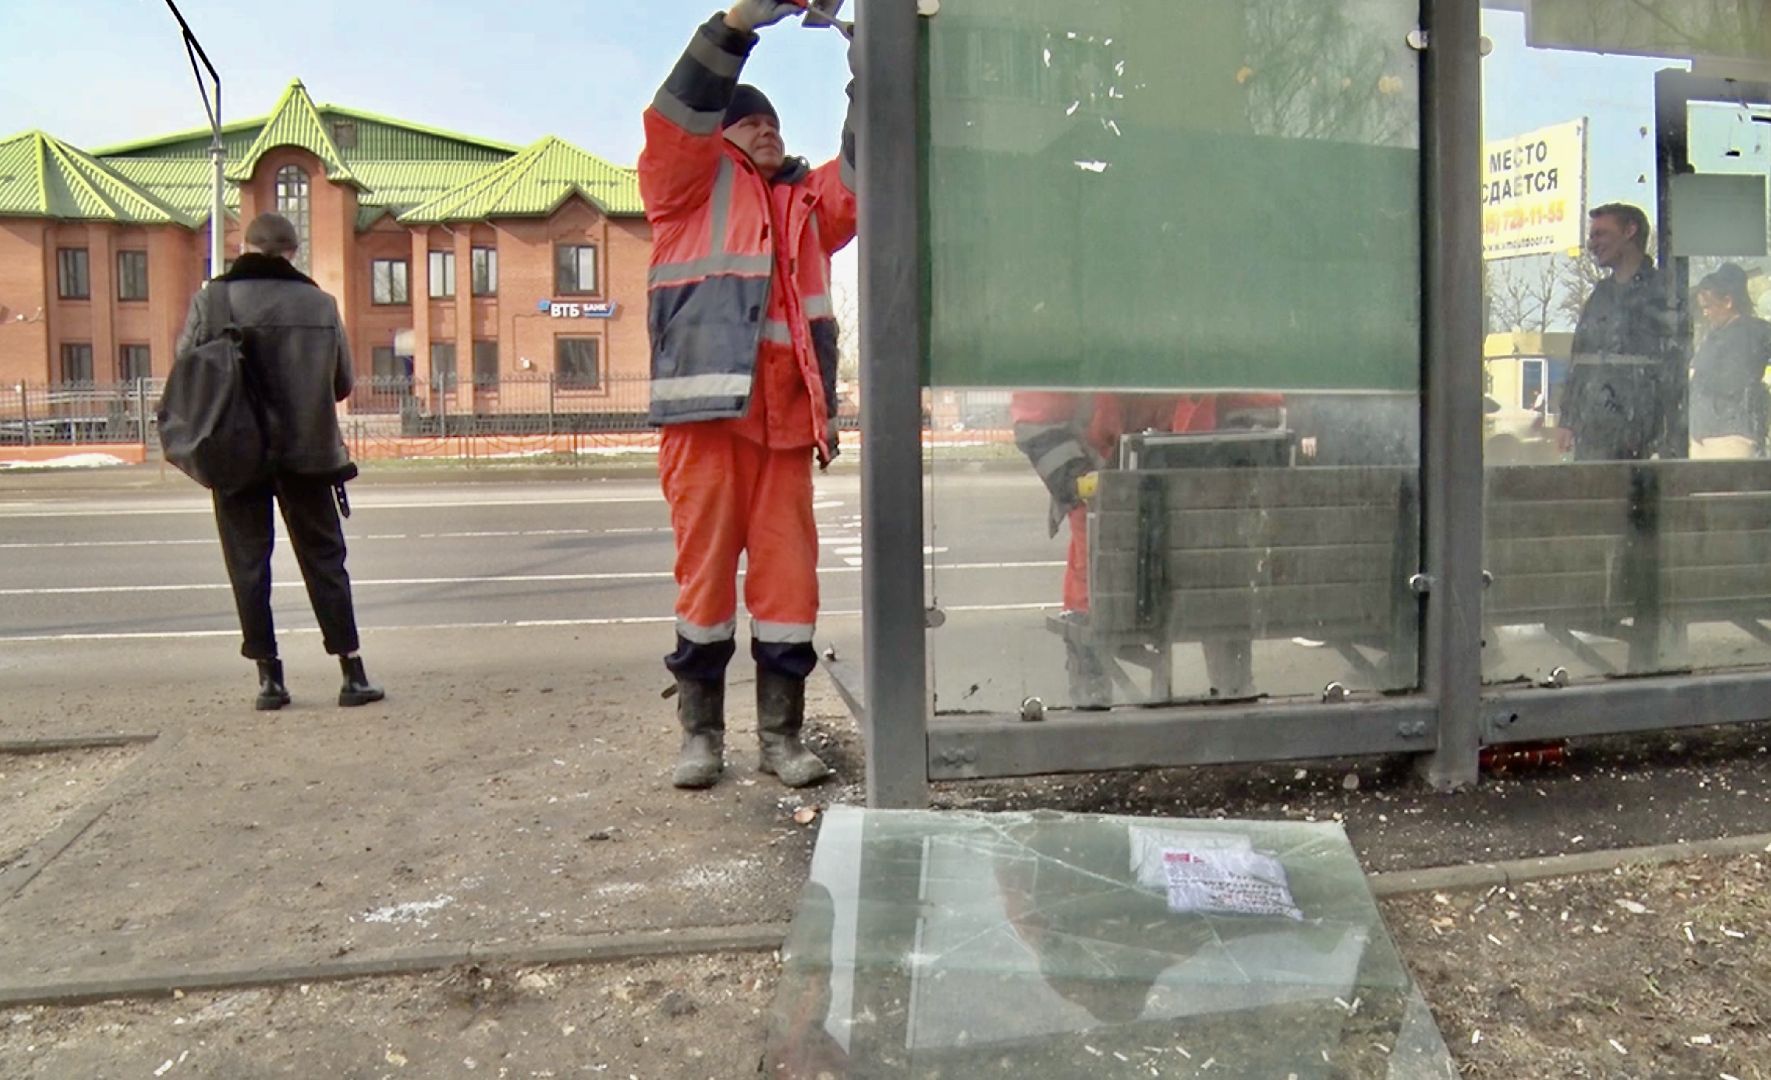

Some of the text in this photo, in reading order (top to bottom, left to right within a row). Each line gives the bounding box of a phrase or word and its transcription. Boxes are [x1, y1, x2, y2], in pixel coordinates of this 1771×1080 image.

[1490, 141, 1547, 173] МЕСТО
[1482, 168, 1558, 206] СДАЕТСЯ
[551, 304, 580, 317] ВТБ
